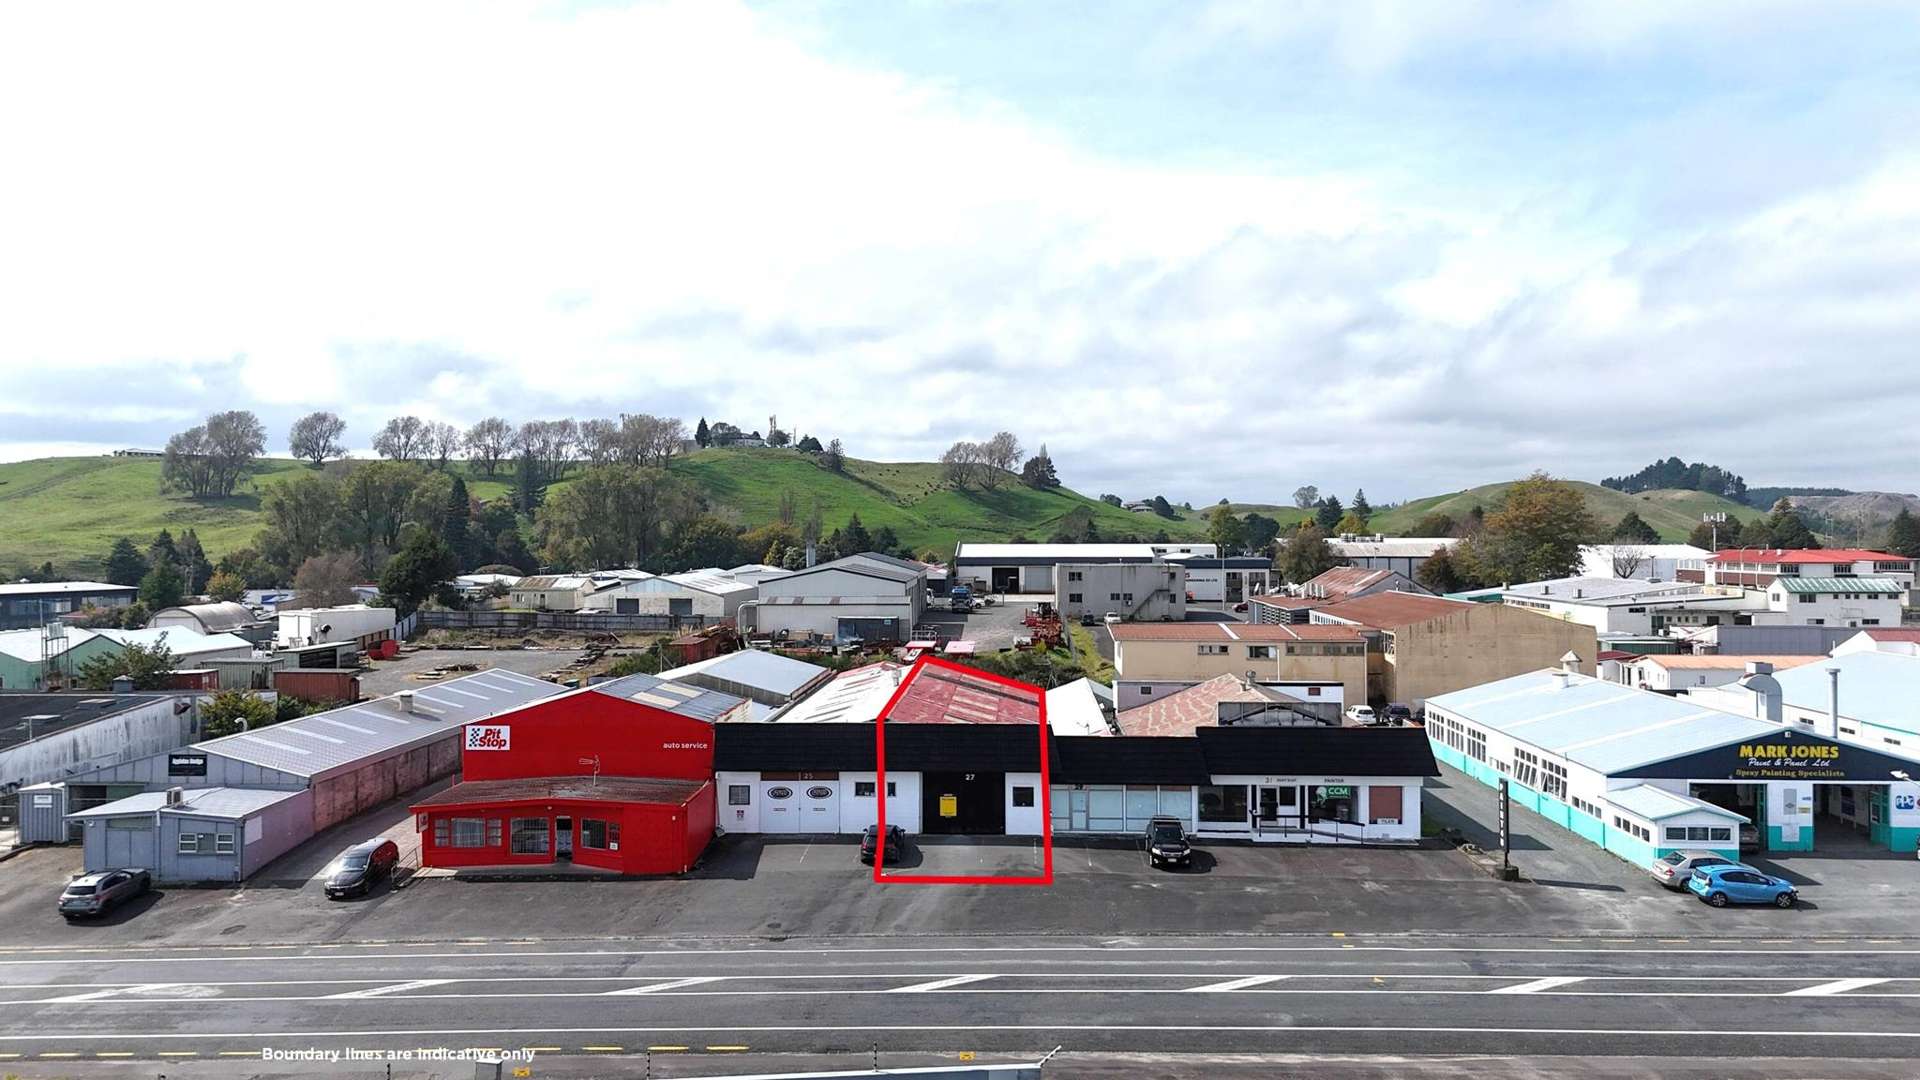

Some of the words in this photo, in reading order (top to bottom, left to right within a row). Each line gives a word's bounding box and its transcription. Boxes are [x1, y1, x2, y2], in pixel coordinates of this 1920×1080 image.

[484, 728, 501, 738] Pit
[478, 737, 507, 749] Stop
[1739, 745, 1788, 758] MARK
[1790, 745, 1839, 758] JONES
[1748, 758, 1772, 767] Paint
[1774, 758, 1781, 766] &
[1783, 758, 1808, 767] Panel
[1812, 758, 1831, 767] Ltd
[1736, 768, 1759, 777] Spray
[1761, 769, 1796, 777] Painting
[1797, 769, 1845, 778] Specialists
[1328, 787, 1348, 795] CCM
[1896, 795, 1914, 808] PPG
